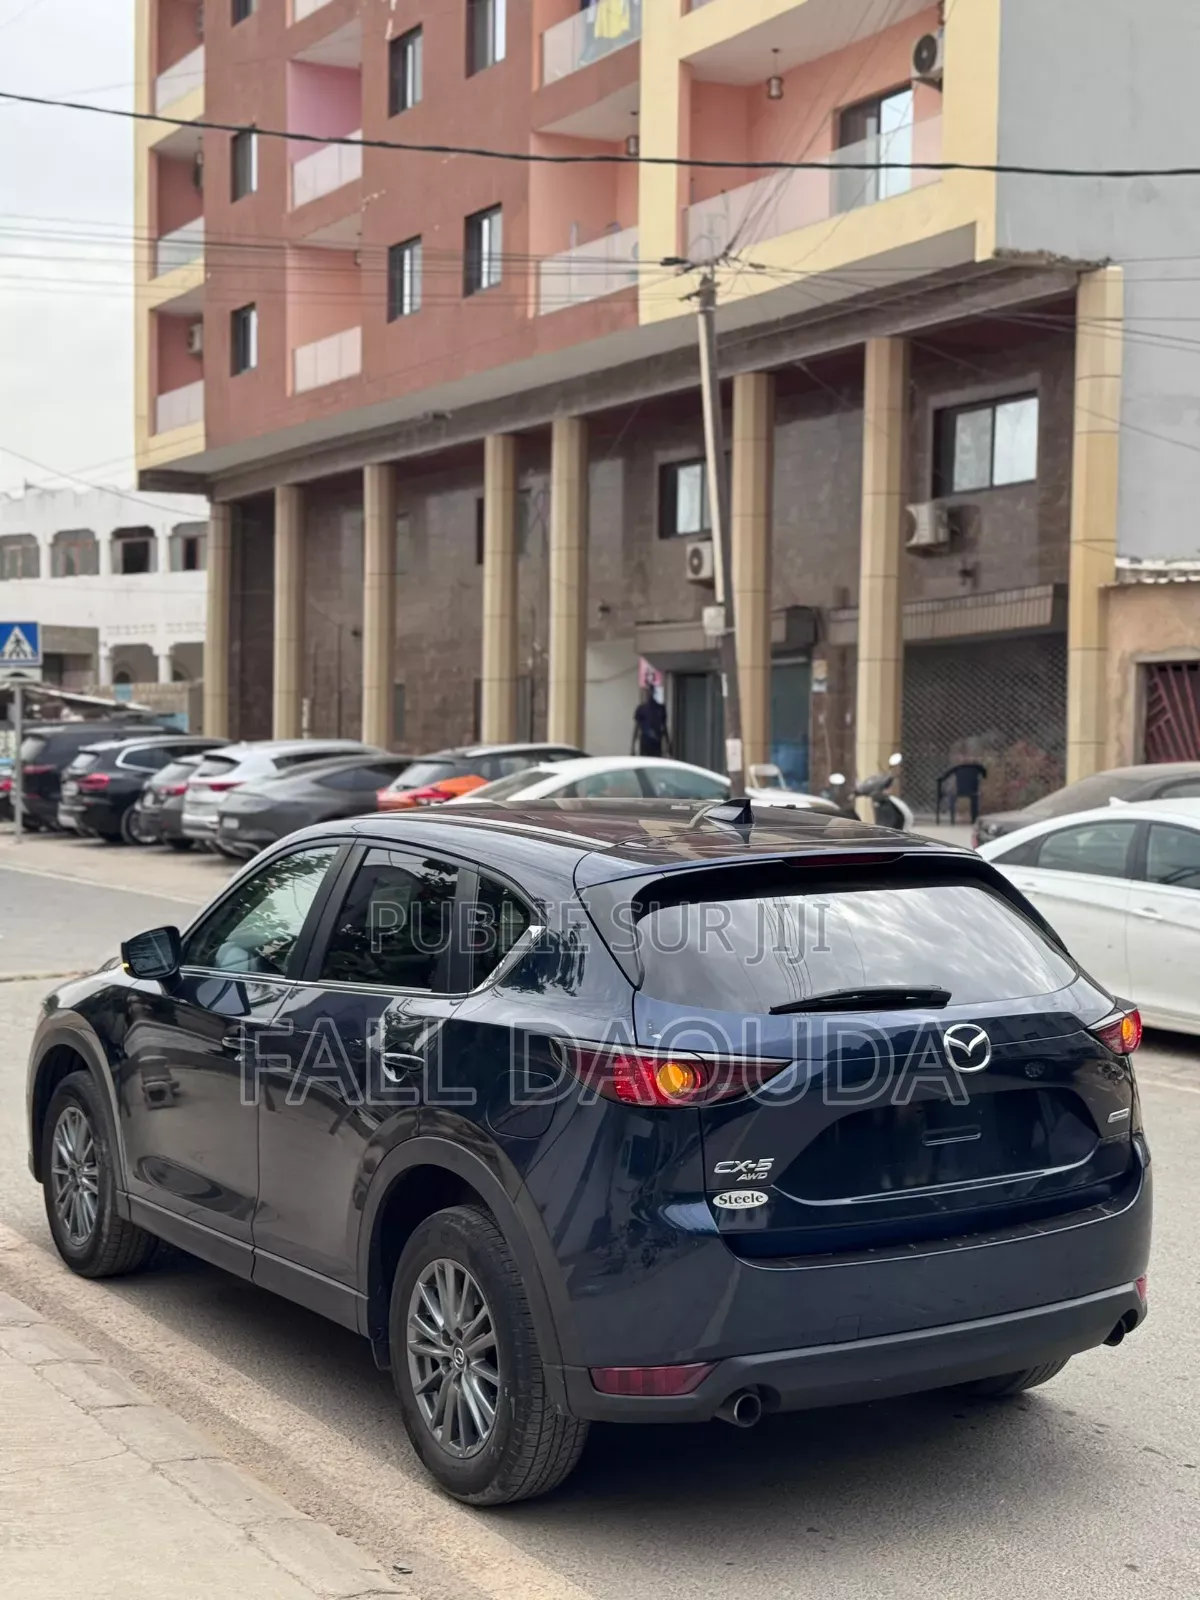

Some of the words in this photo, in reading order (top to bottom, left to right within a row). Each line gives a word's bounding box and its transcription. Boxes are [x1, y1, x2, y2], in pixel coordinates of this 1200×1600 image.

[714, 1158, 775, 1173] CX-5
[736, 1172, 768, 1181] AWD
[719, 1193, 763, 1205] Steele
